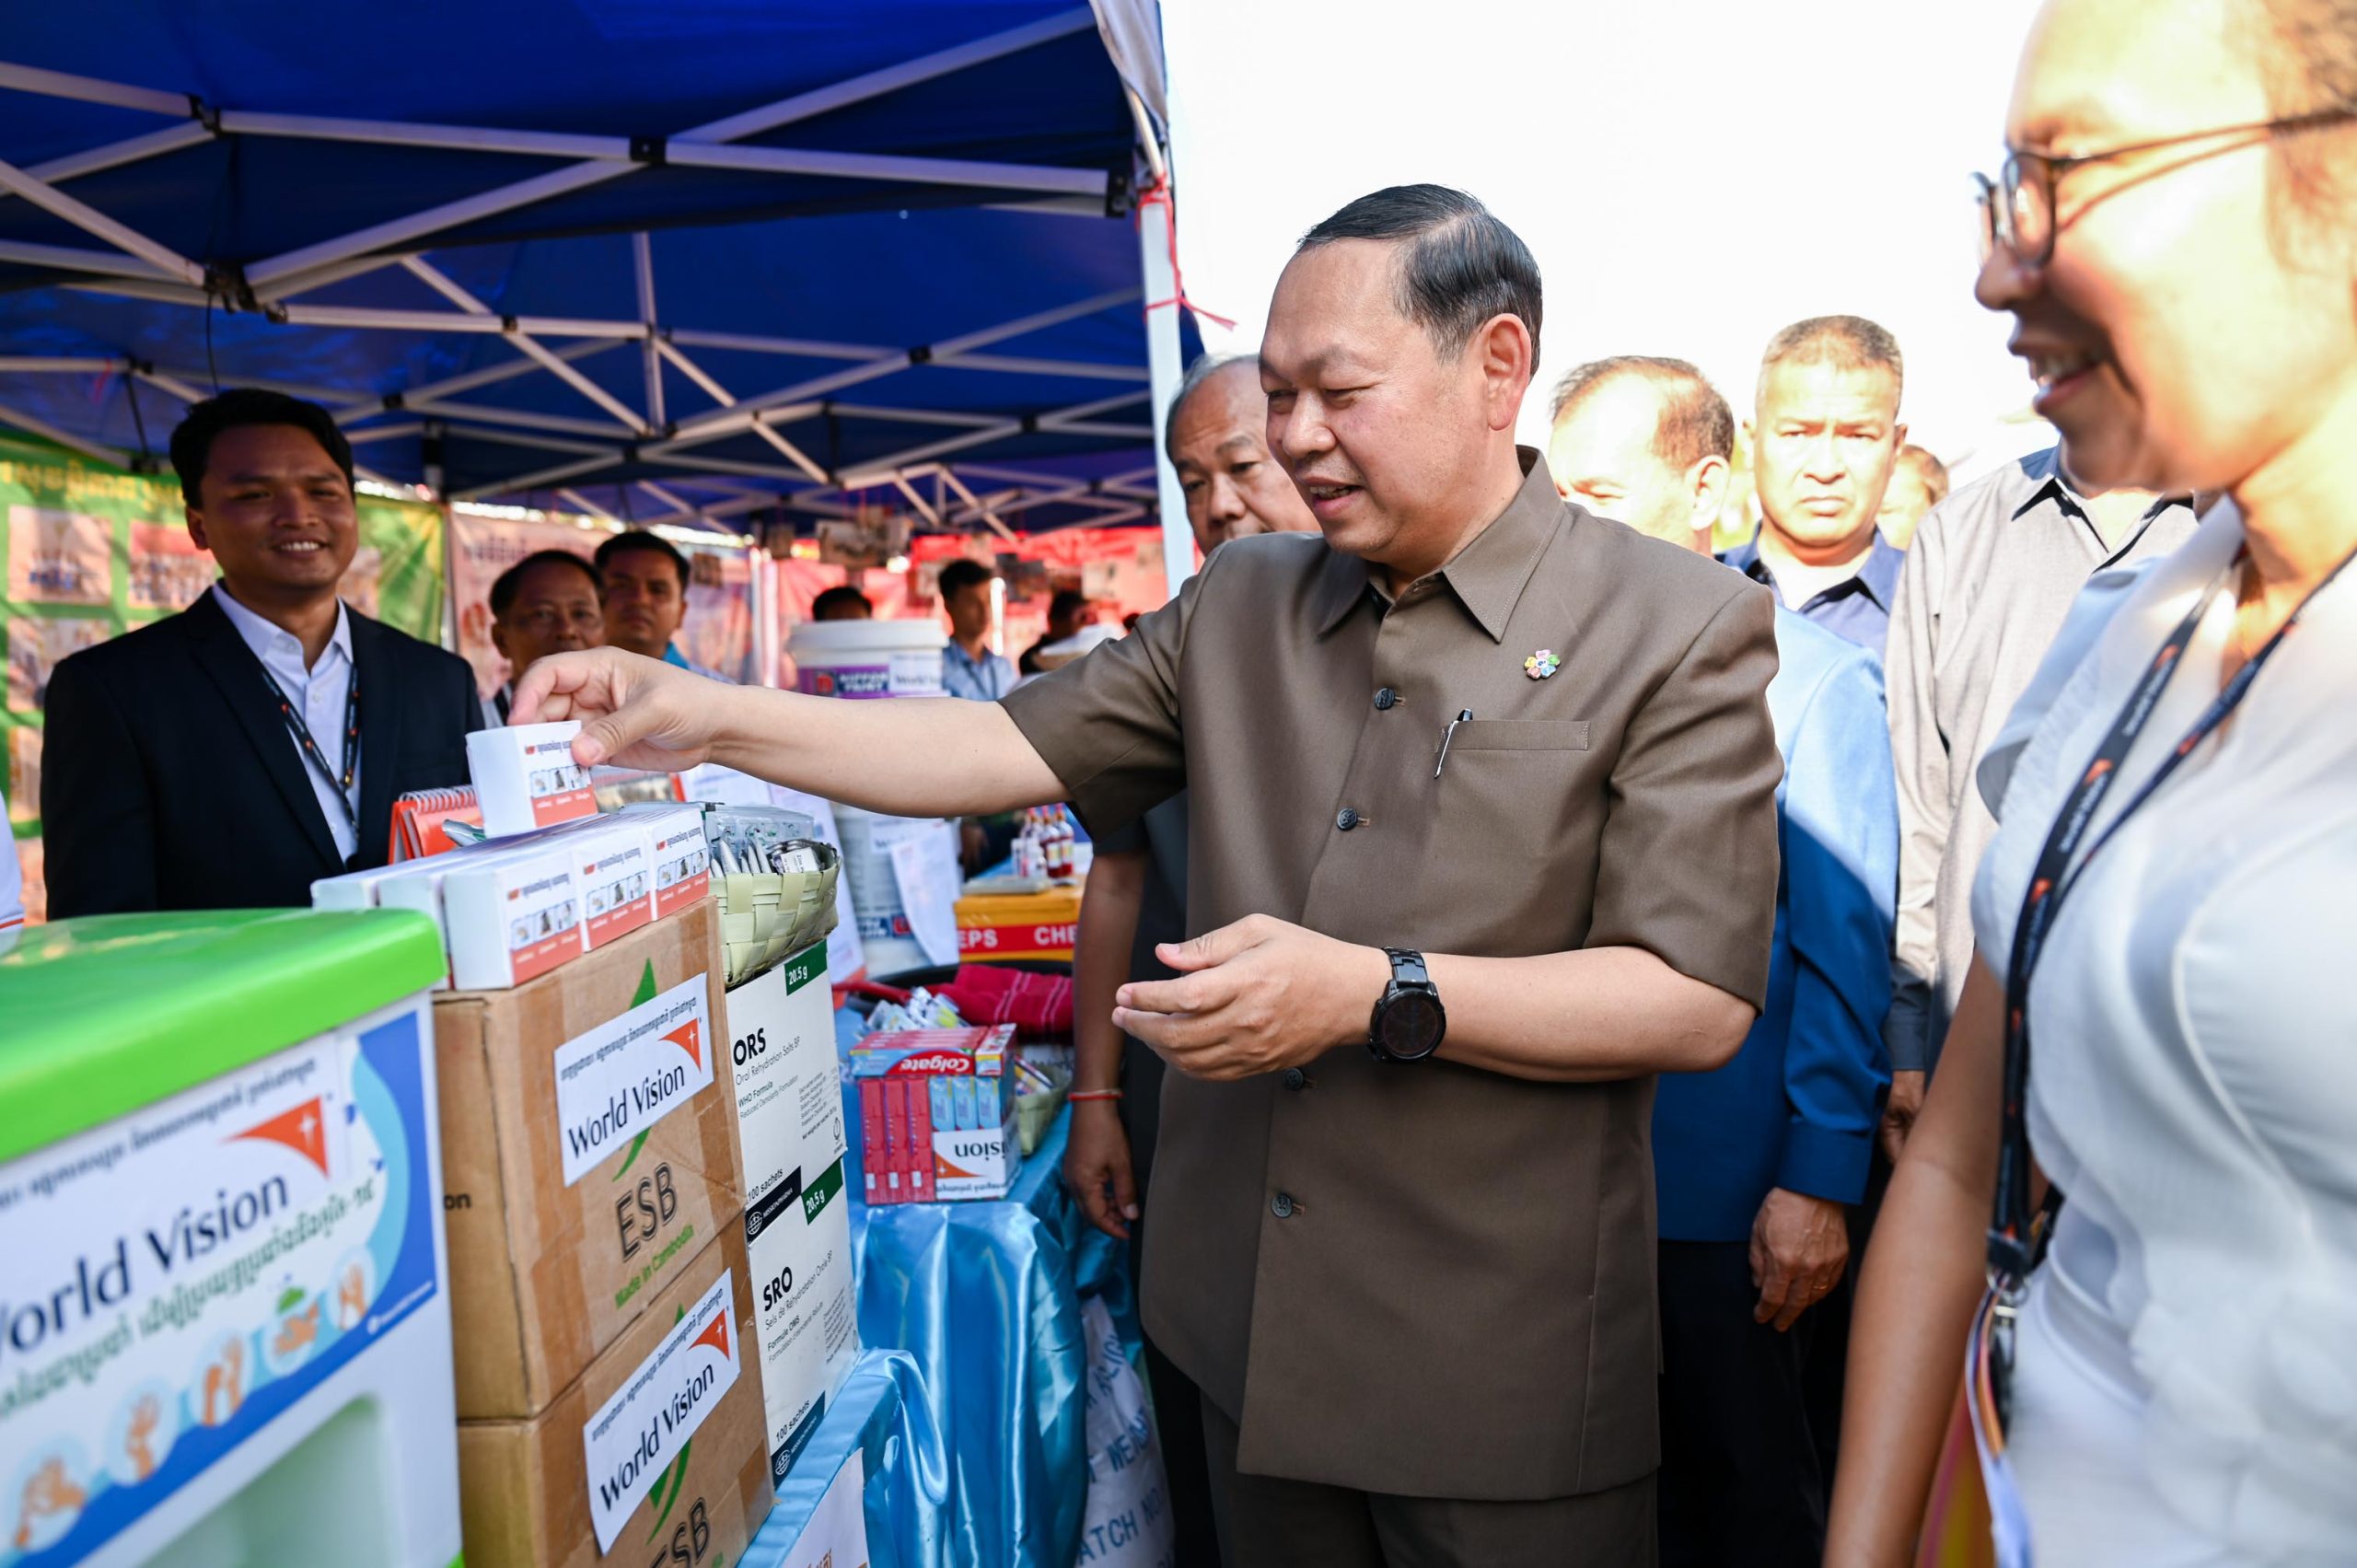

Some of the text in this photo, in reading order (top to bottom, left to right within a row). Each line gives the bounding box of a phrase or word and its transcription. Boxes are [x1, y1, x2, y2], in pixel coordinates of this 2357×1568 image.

[958, 928, 998, 949] EPS
[788, 966, 802, 986] 20.5
[733, 1028, 766, 1066] ORS
[900, 1055, 970, 1072] Colgate
[736, 1064, 750, 1086] Oral
[751, 1049, 783, 1078] Rehydration
[568, 1064, 685, 1159] World Vision
[737, 1081, 773, 1108] WHO Formula
[955, 1142, 1005, 1162] ision
[444, 1193, 470, 1211] on
[748, 1168, 784, 1202] 100 sachets
[146, 1175, 289, 1273] Vision
[615, 1162, 678, 1263] ESB
[763, 1266, 793, 1312] SRO
[765, 1313, 778, 1330] Sels
[767, 1327, 789, 1353] Formule
[599, 1416, 660, 1512] World
[663, 1364, 714, 1434] Vision
[775, 1400, 810, 1443] 100 sachets
[1076, 1510, 1139, 1566] ATCH
